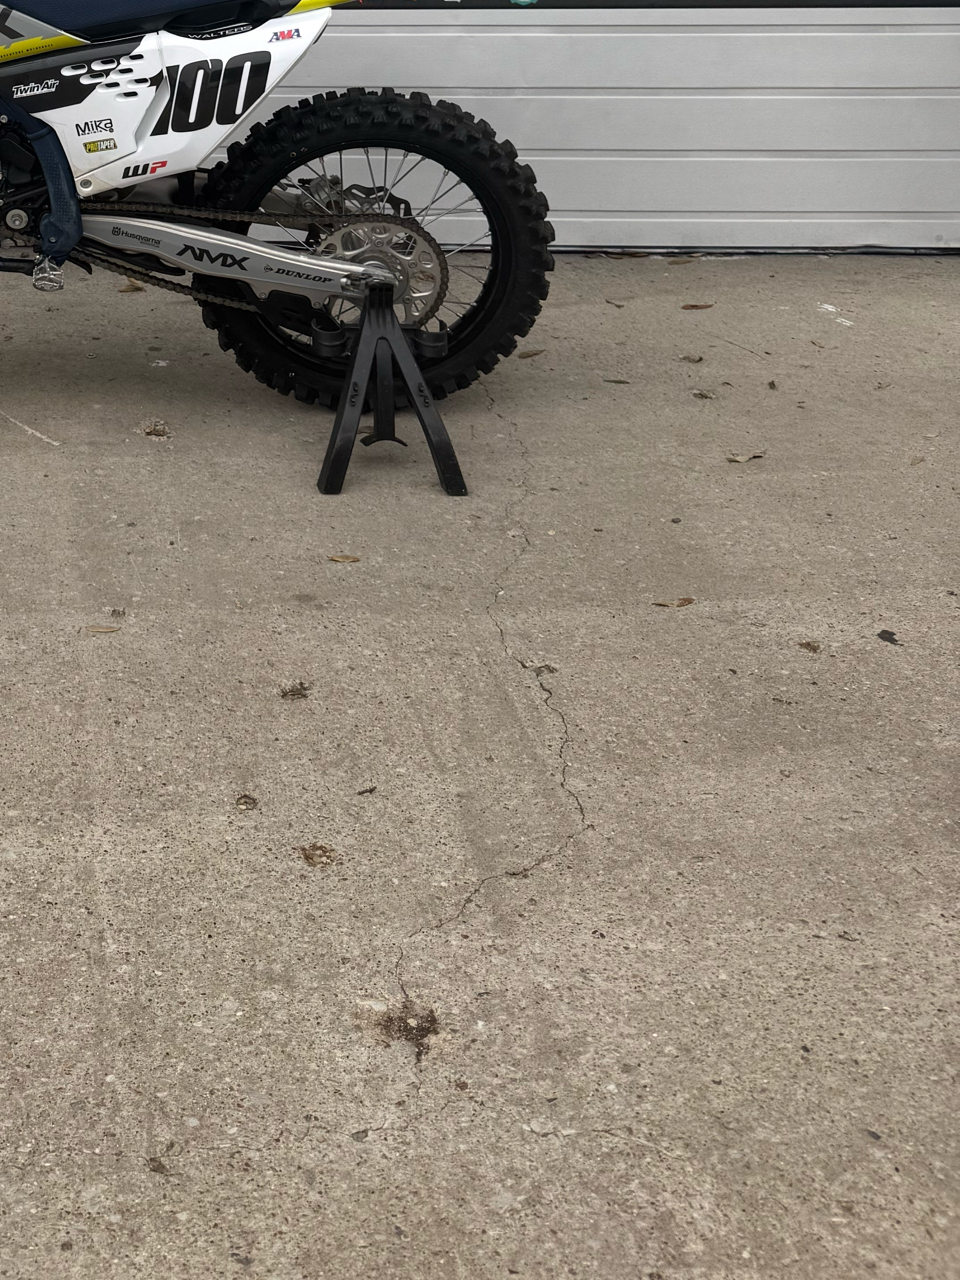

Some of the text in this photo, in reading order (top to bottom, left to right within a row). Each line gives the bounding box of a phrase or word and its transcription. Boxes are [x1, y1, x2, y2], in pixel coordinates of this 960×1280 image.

[188, 24, 253, 40] WALTERS
[268, 28, 303, 43] AMA
[13, 82, 41, 97] Twin
[41, 78, 60, 92] Air
[148, 51, 271, 136] 100
[86, 139, 115, 153] PROTAPER
[122, 160, 168, 179] WP
[121, 230, 161, 246] Husqvarna
[176, 243, 250, 271] AMX
[275, 267, 334, 284] DUNLOP
